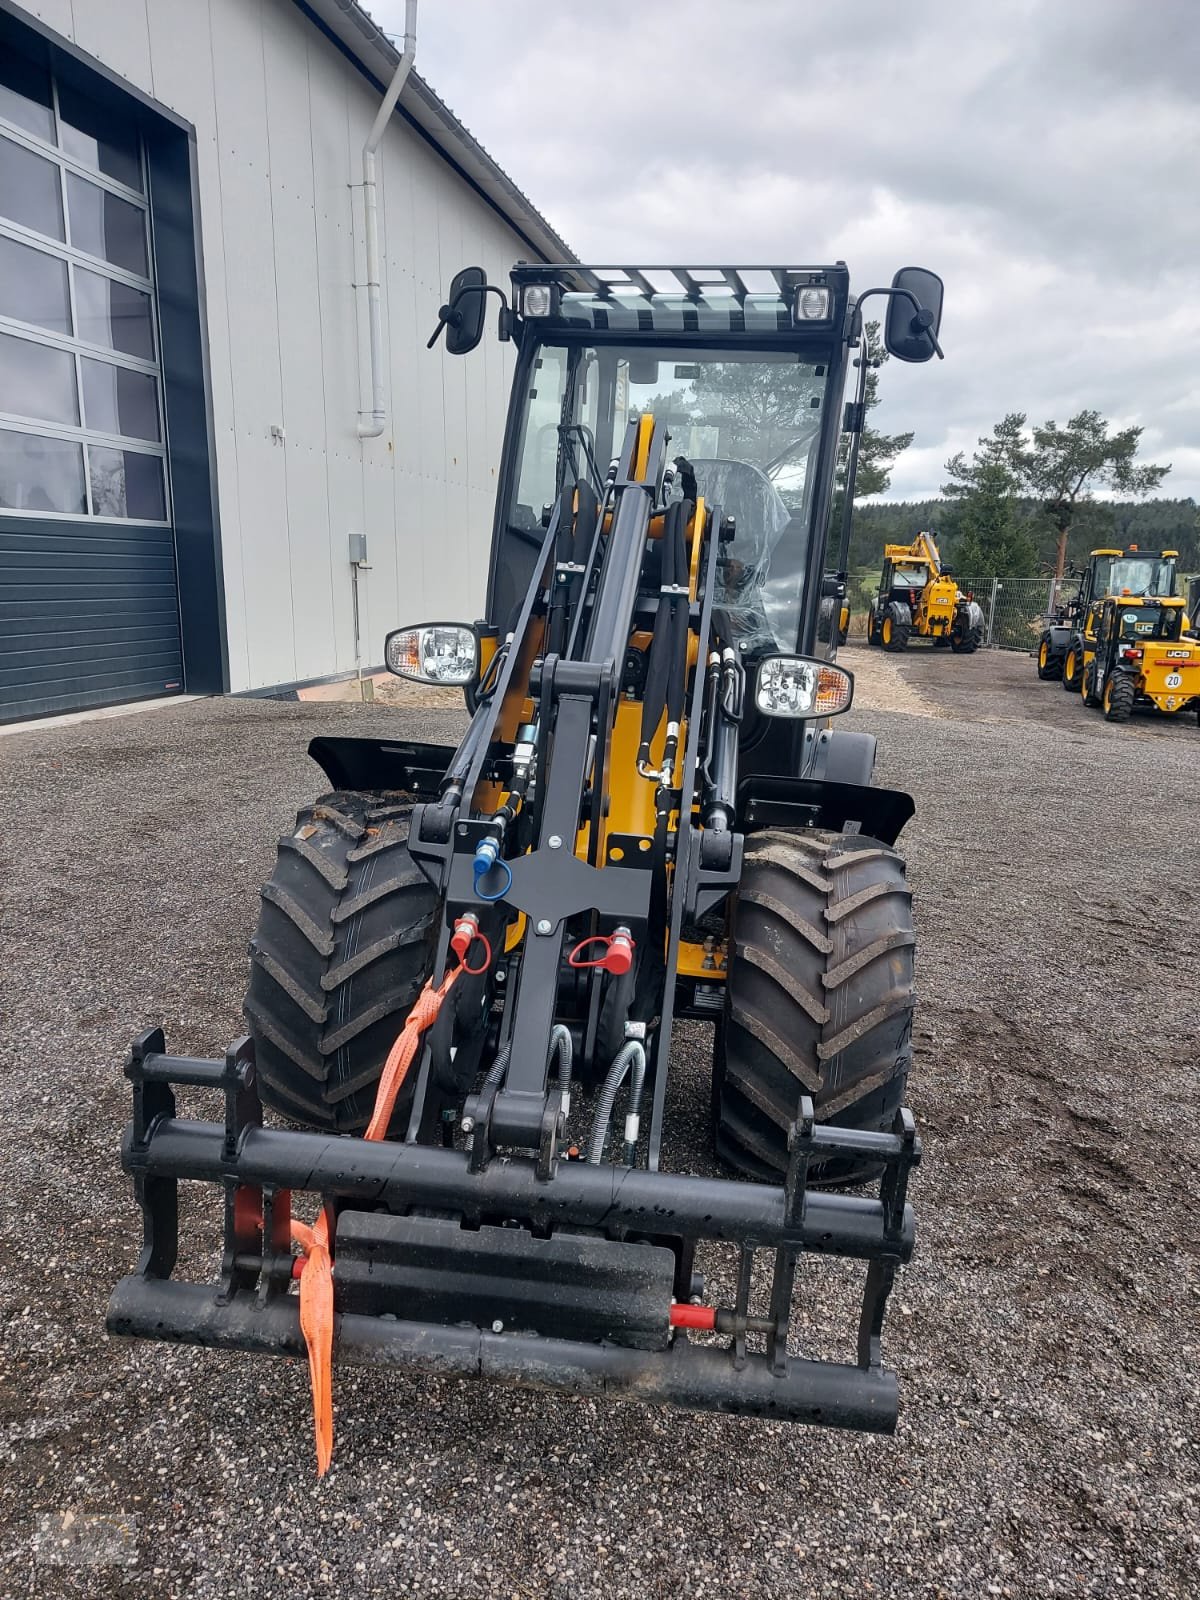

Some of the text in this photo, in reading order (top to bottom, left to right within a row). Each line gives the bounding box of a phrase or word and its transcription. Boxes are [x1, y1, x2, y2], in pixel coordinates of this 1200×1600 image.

[1136, 624, 1153, 632] JC
[1167, 650, 1190, 658] JCB
[1168, 676, 1179, 685] 20
